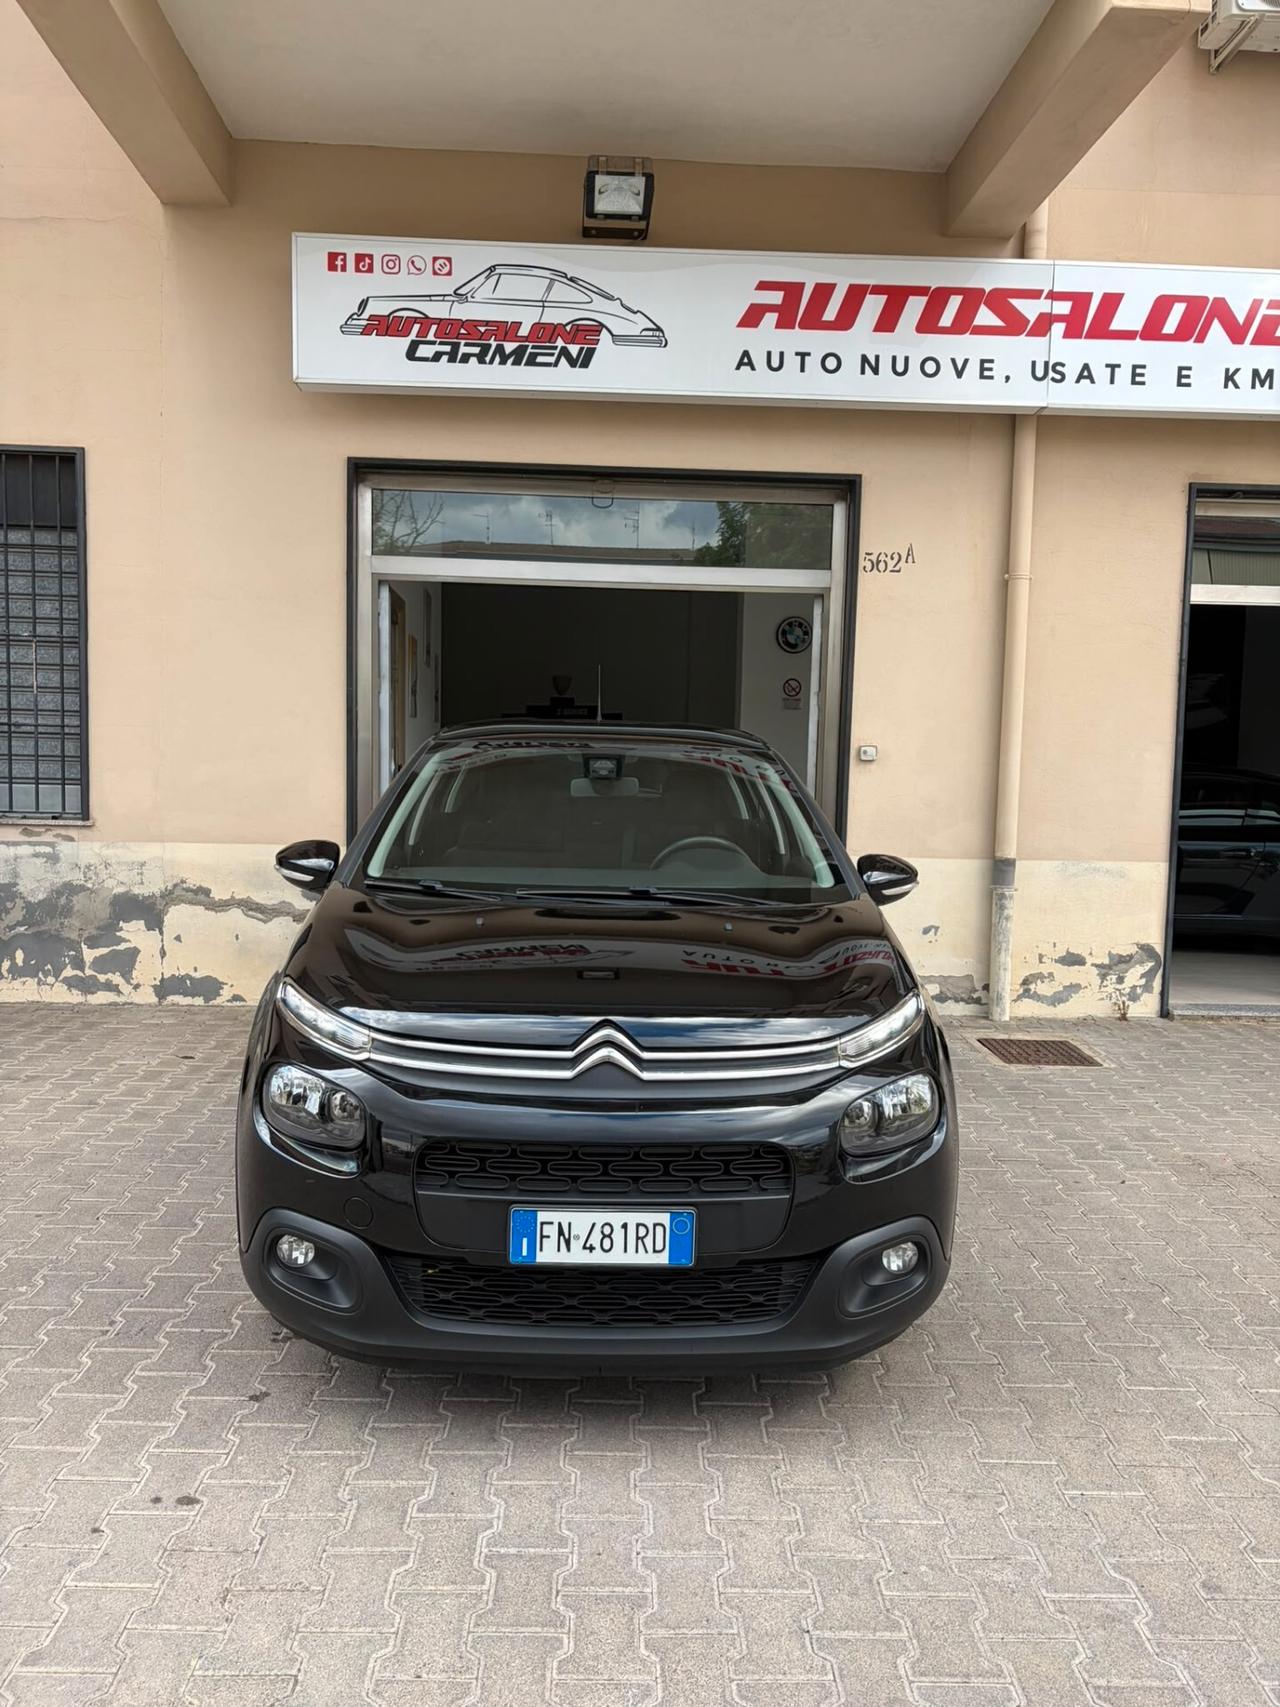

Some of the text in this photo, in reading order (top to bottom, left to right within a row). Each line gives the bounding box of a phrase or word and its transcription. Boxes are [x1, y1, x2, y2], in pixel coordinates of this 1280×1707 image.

[361, 314, 603, 346] AUTOSALONE
[405, 339, 597, 370] CARMENI
[735, 349, 1275, 390] AUTO NUOVE, USATE E KM
[539, 1221, 667, 1254] FN 481RD
